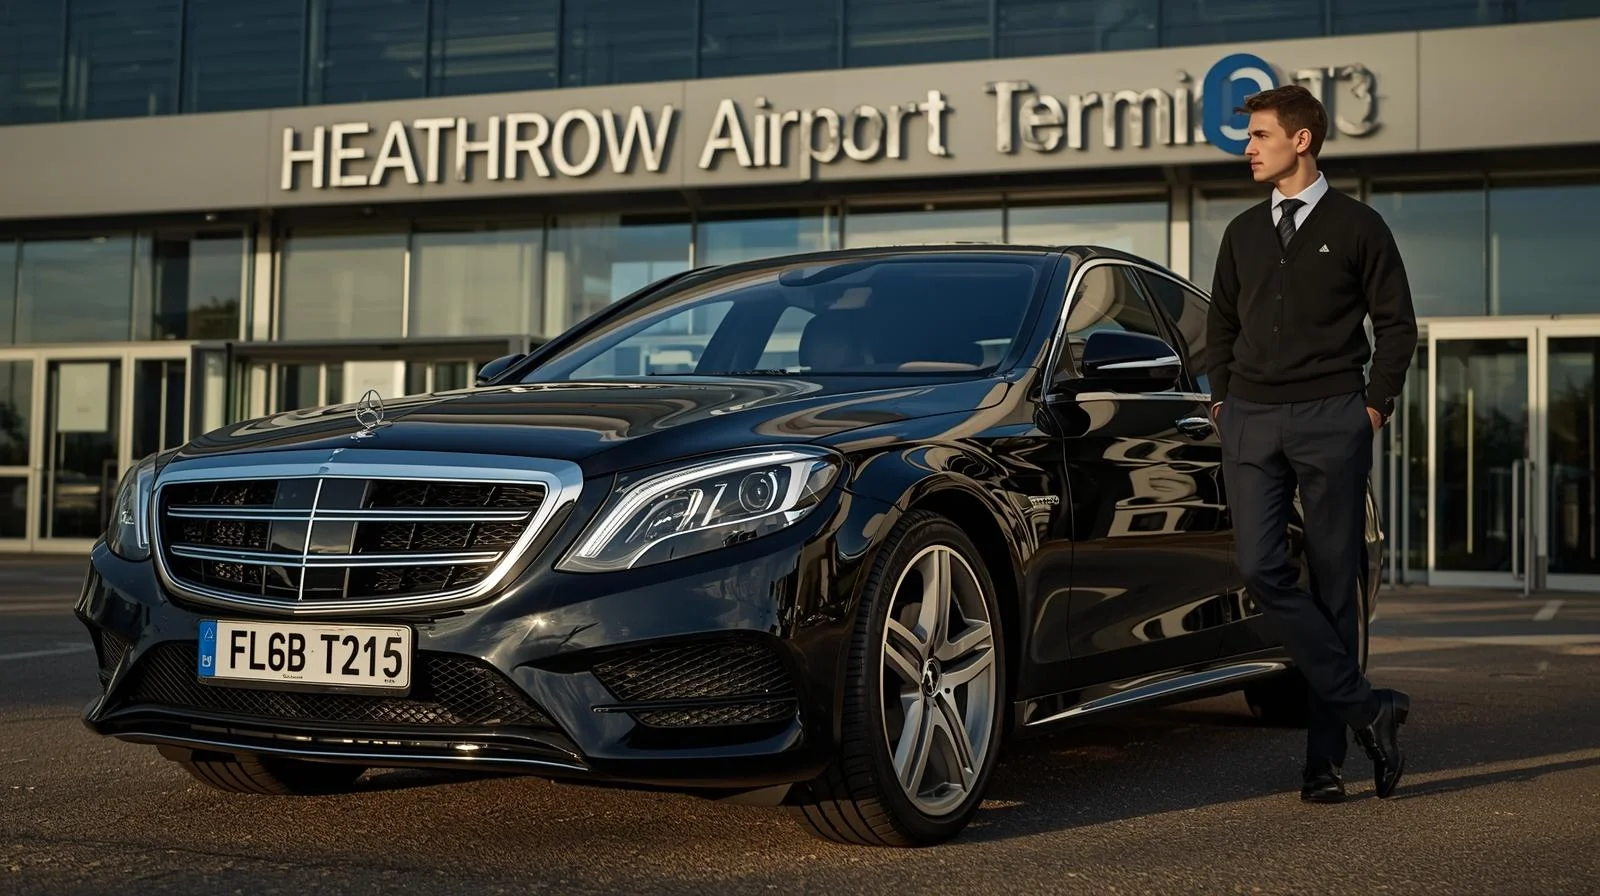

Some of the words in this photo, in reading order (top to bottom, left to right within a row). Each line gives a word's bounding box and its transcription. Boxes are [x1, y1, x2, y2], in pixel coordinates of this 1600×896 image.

[281, 105, 674, 190] HEATHROW
[698, 90, 950, 180] Airport
[230, 630, 306, 672] FL6B
[320, 634, 403, 678] T215
